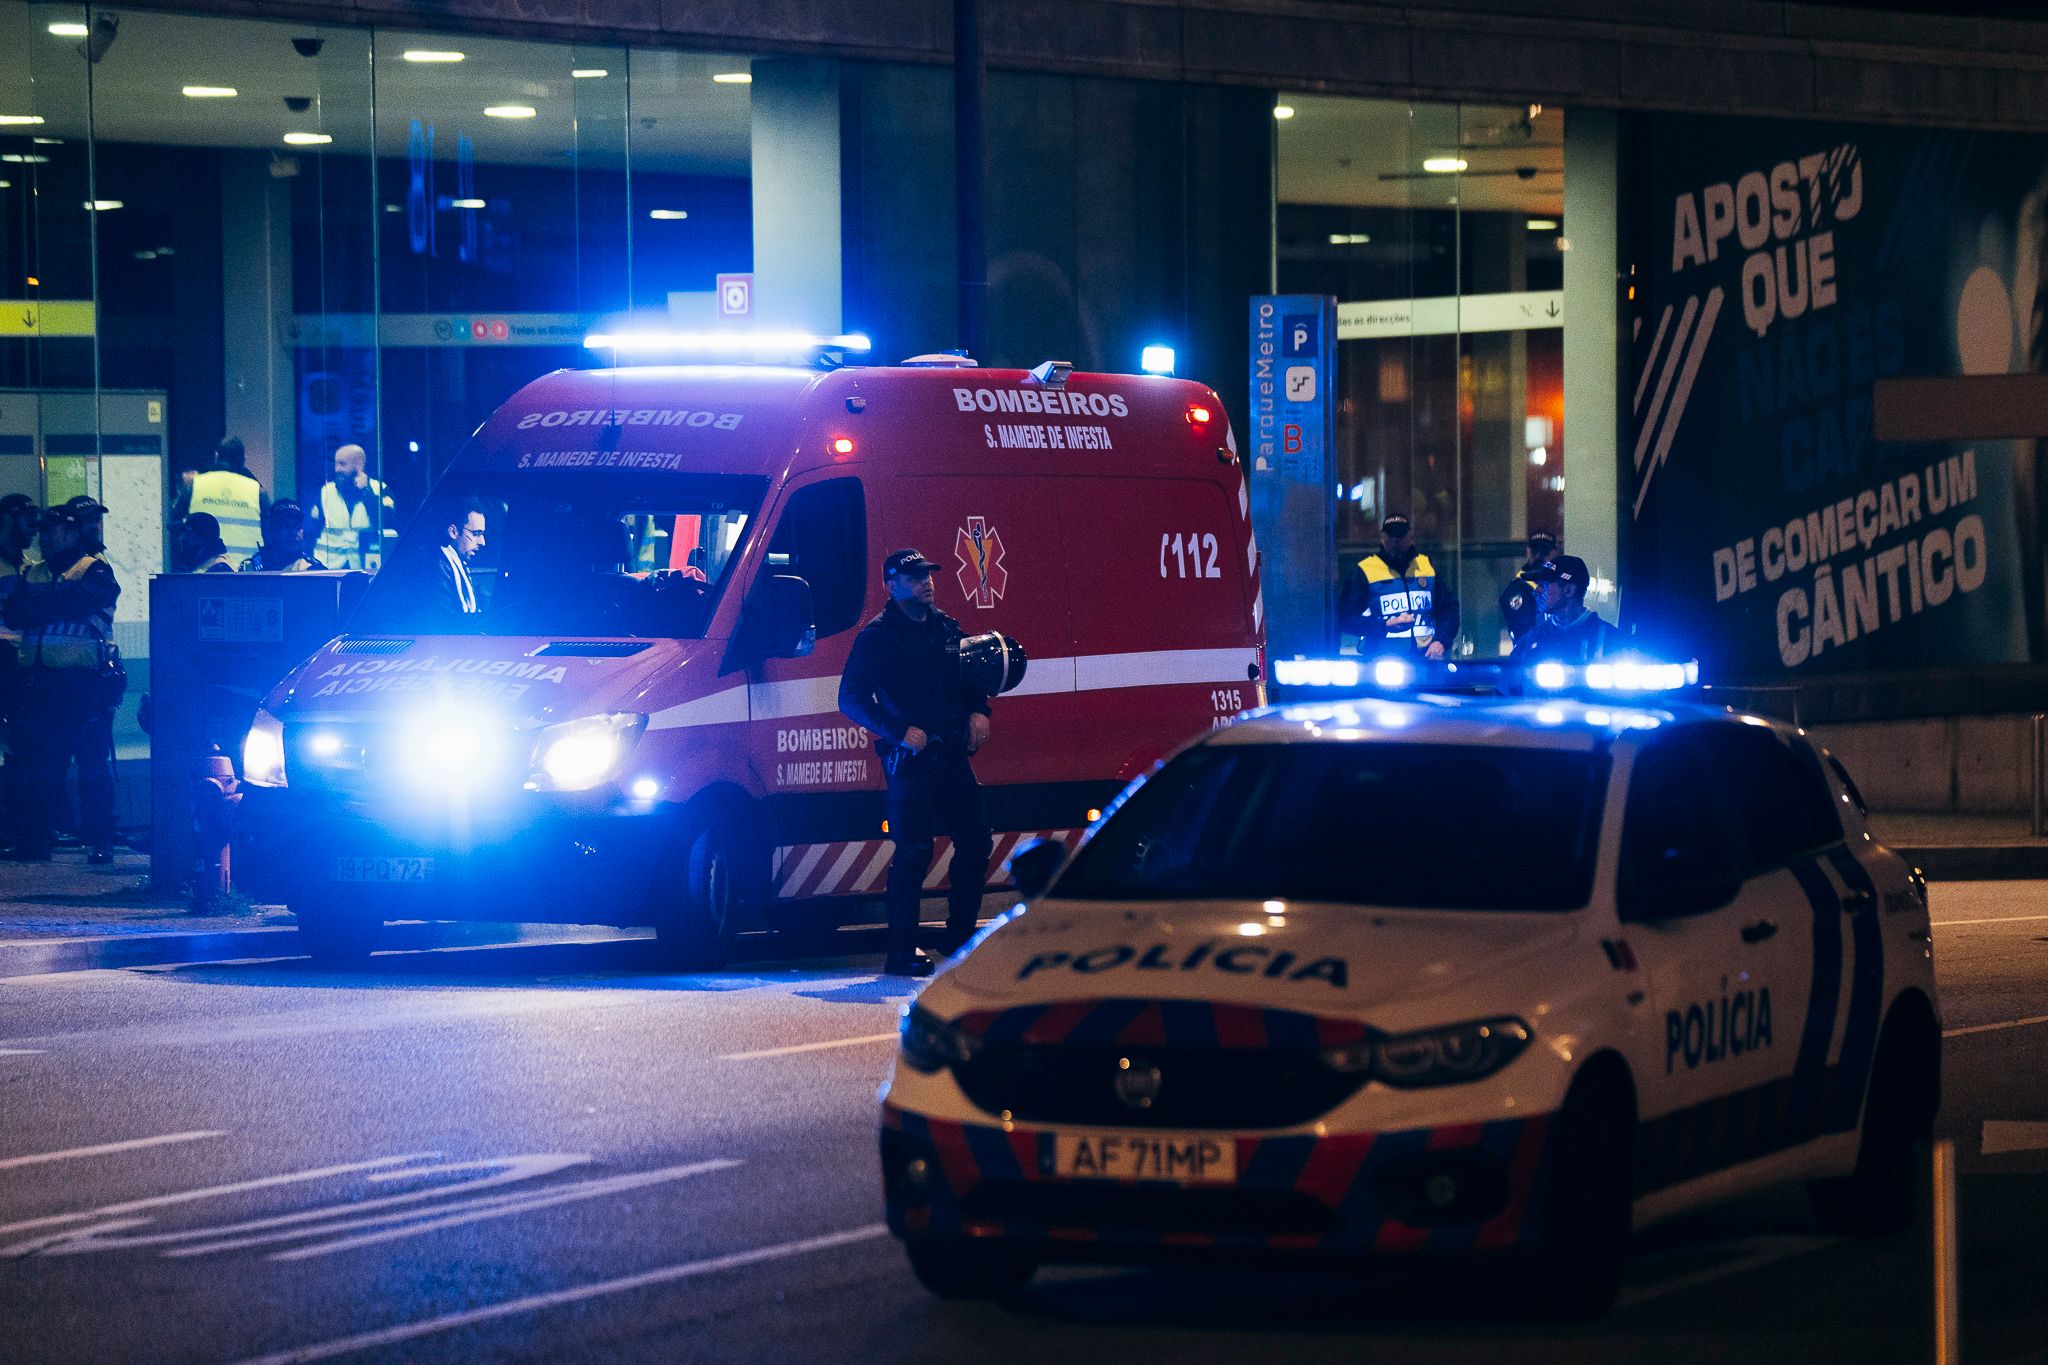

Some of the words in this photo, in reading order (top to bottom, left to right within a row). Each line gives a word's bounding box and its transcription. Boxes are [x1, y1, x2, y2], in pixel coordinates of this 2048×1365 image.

[1742, 230, 1838, 338] QUE
[953, 388, 1129, 417] BOMBEIROS
[1255, 303, 1274, 471] ParqueMetro
[984, 424, 998, 448] S.
[998, 424, 1047, 449] MAMEDE
[1047, 425, 1065, 449] DE
[1065, 426, 1113, 450] INFESTA
[1283, 423, 1302, 454] B
[518, 452, 530, 468] S.
[534, 450, 594, 468] MAMEDE
[595, 451, 620, 467] DE
[618, 452, 683, 470] INFESTA
[1713, 537, 1757, 602] DE
[1761, 472, 1922, 583] COMEÇAR
[1925, 449, 1978, 515] UM
[1172, 533, 1221, 578] 112
[1776, 514, 1987, 667] CÂNTICO
[1211, 689, 1242, 710] 1315
[777, 726, 868, 752] BOMBEIROS
[777, 763, 785, 786] S.
[786, 761, 821, 785] MAMEDE
[822, 761, 833, 784] DE
[834, 759, 867, 783] INFESTA
[1016, 939, 1349, 989] POLÍCIA
[1664, 973, 1773, 1075] POLÍCIA
